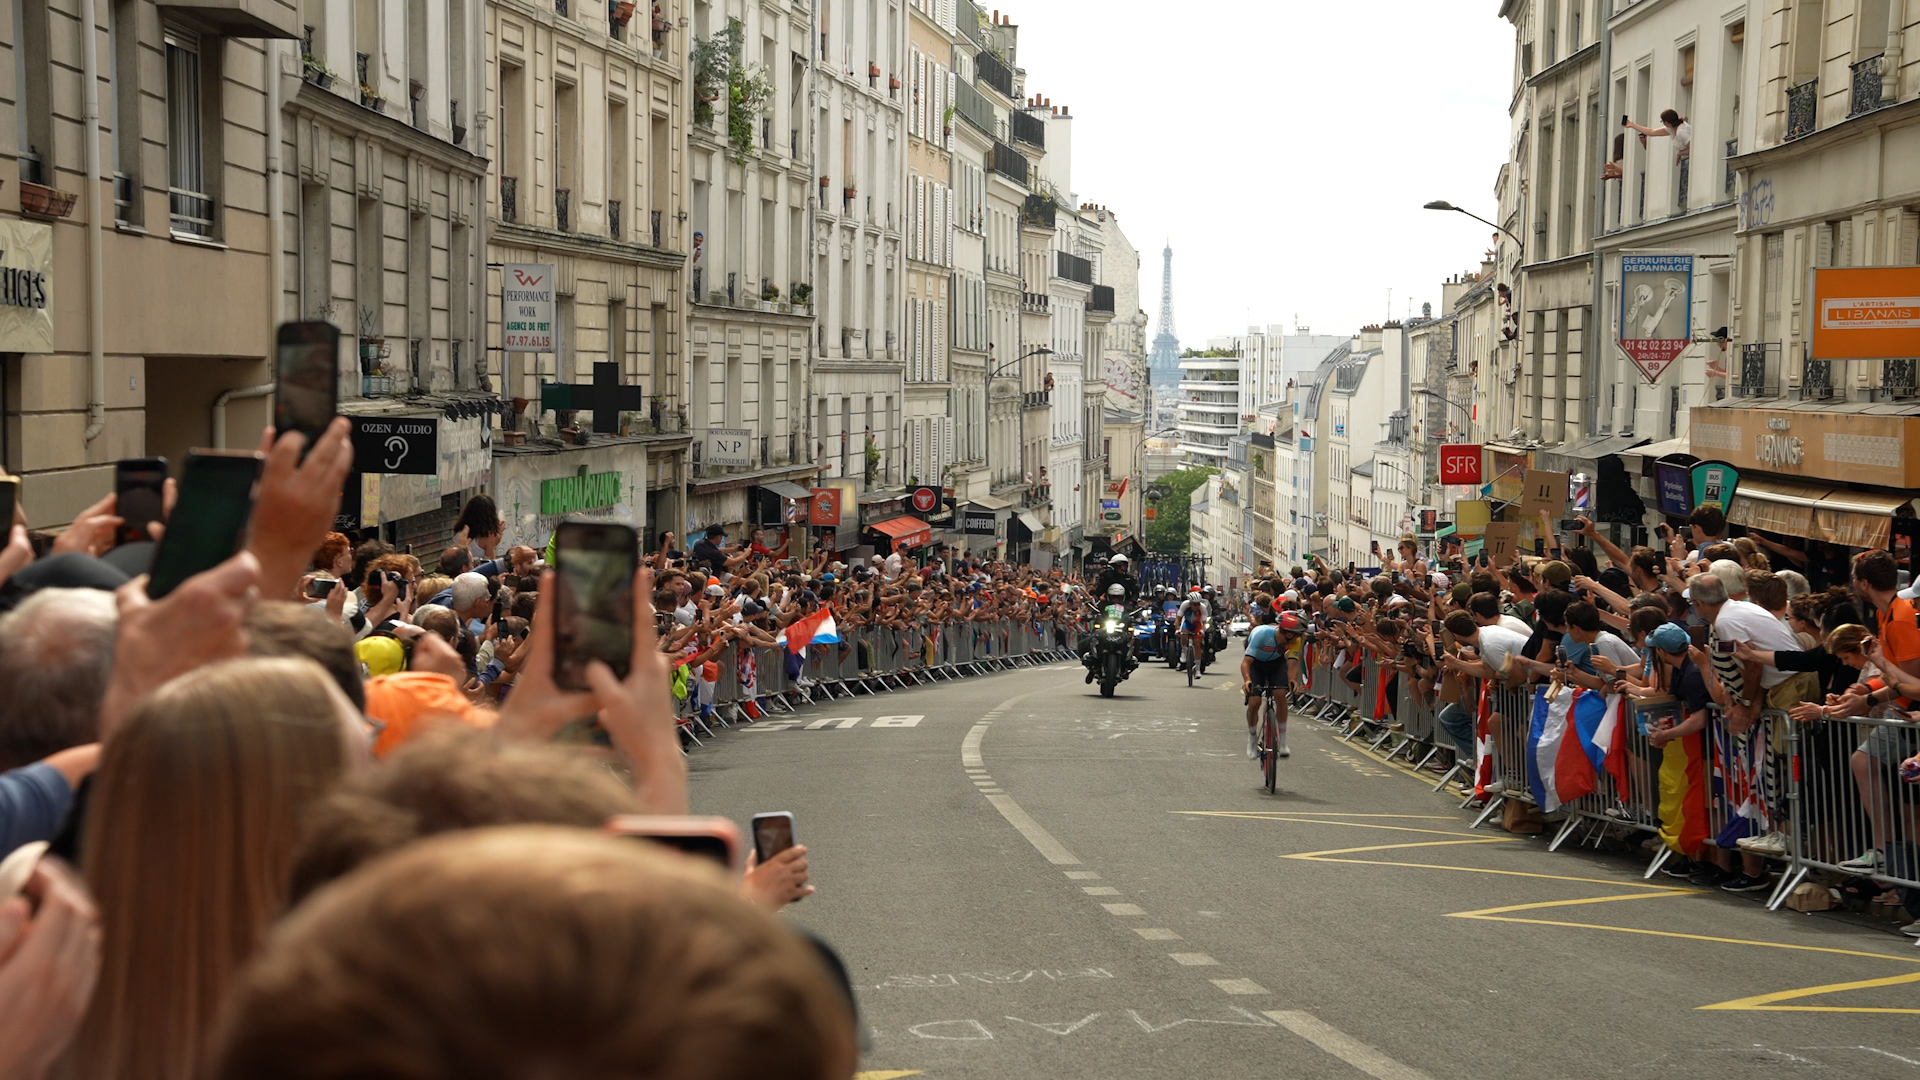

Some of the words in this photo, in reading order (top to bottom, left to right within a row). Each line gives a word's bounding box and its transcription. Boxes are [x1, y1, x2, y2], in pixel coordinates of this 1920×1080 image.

[1623, 256, 1692, 264] SERRURERIE
[1624, 264, 1690, 272] DEPANNAGE
[506, 290, 550, 303] PERFORMANCE
[518, 306, 537, 318] WORK
[1836, 308, 1912, 320] LIBANAIS
[506, 321, 527, 331] AGENCE
[528, 322, 536, 331] DE
[537, 322, 550, 332] FRET
[506, 335, 550, 347] 47.97.61.15
[1625, 341, 1635, 350] 01
[1637, 341, 1648, 350] 42
[1649, 341, 1660, 350] 02
[1661, 341, 1672, 350] 23
[1673, 341, 1684, 350] 94
[1647, 362, 1660, 371] 89
[361, 423, 392, 434] OZEN
[396, 424, 432, 435] AUDIO
[708, 429, 749, 437] BOULANGERIE
[716, 440, 729, 453] N
[732, 440, 742, 453] P
[709, 456, 748, 466] PÂTISSERIE
[1446, 456, 1476, 474] SFR
[1707, 485, 1718, 495] 71
[965, 518, 995, 530] COIFFEUR
[739, 714, 925, 732] BUS
